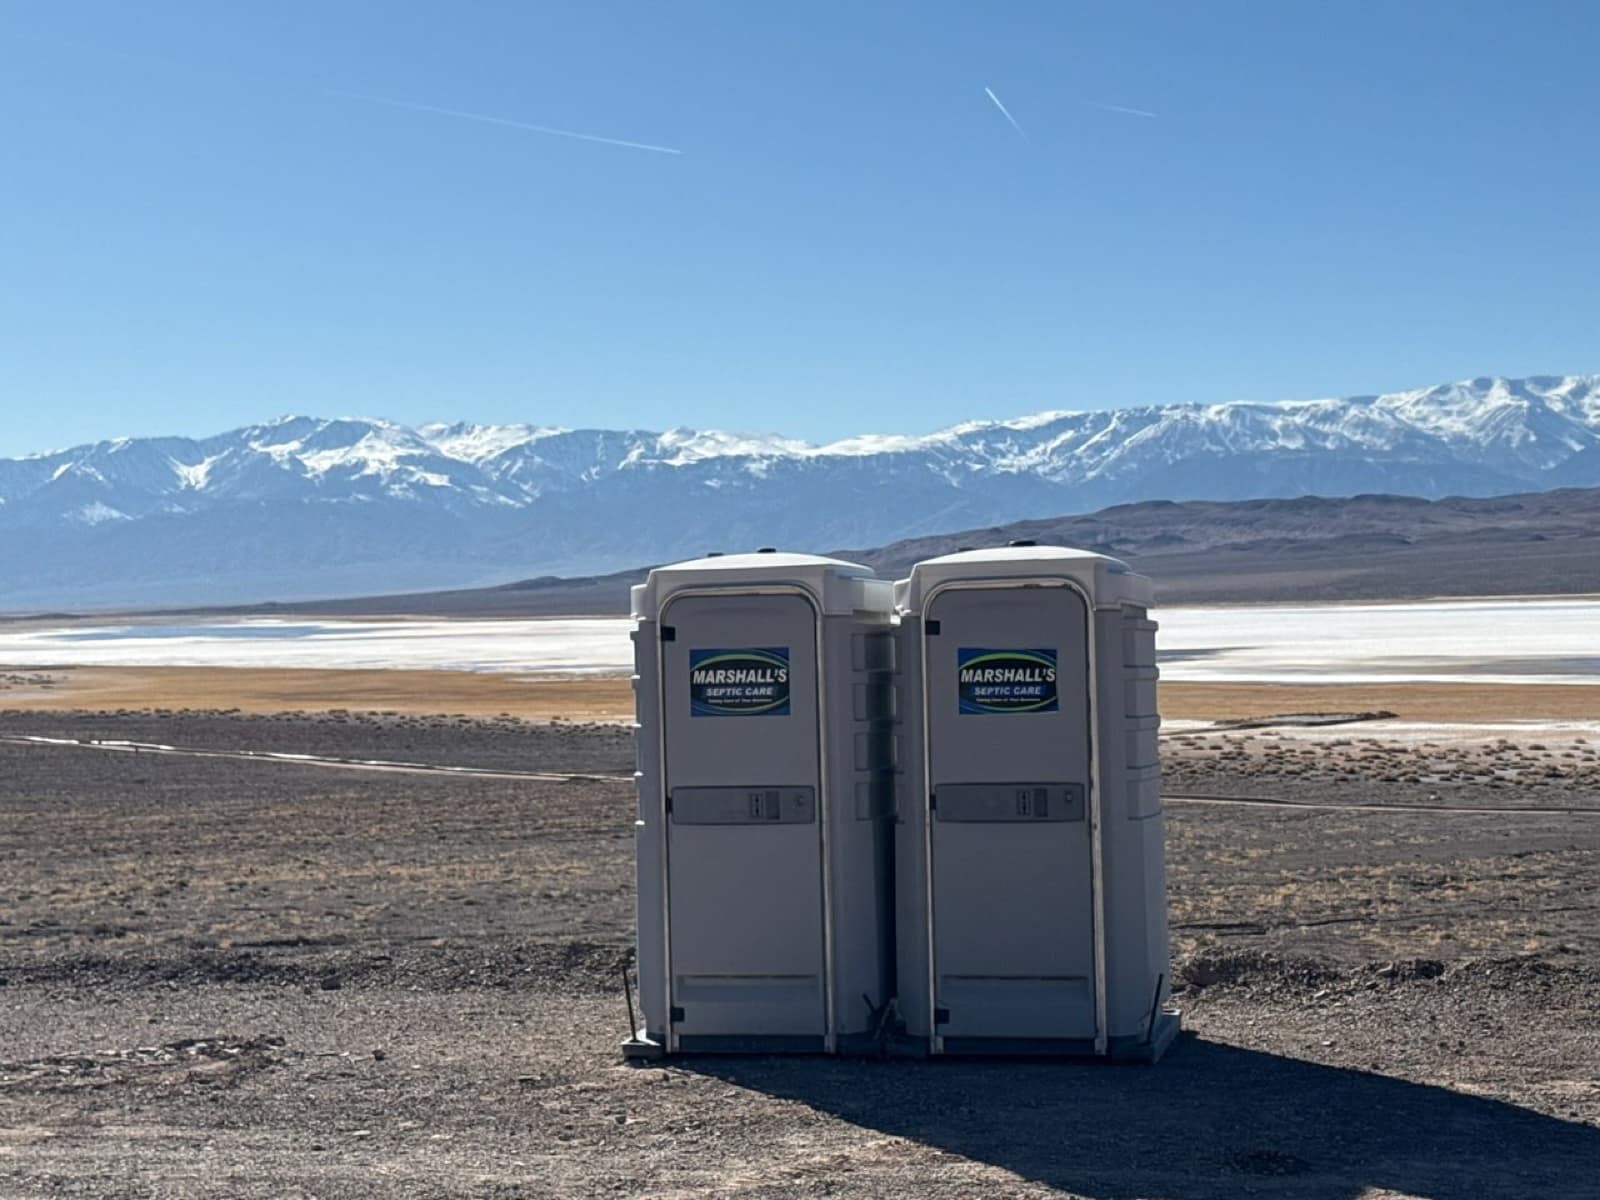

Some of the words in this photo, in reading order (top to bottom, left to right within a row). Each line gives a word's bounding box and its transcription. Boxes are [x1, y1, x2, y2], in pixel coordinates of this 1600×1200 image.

[693, 668, 787, 684] MARSHALL'S
[960, 668, 1056, 683] MARSHALL'S
[706, 687, 742, 696] SEPTIC
[745, 687, 774, 695] CARE
[974, 686, 1010, 695] SEPTIC
[1013, 686, 1041, 695] CARE
